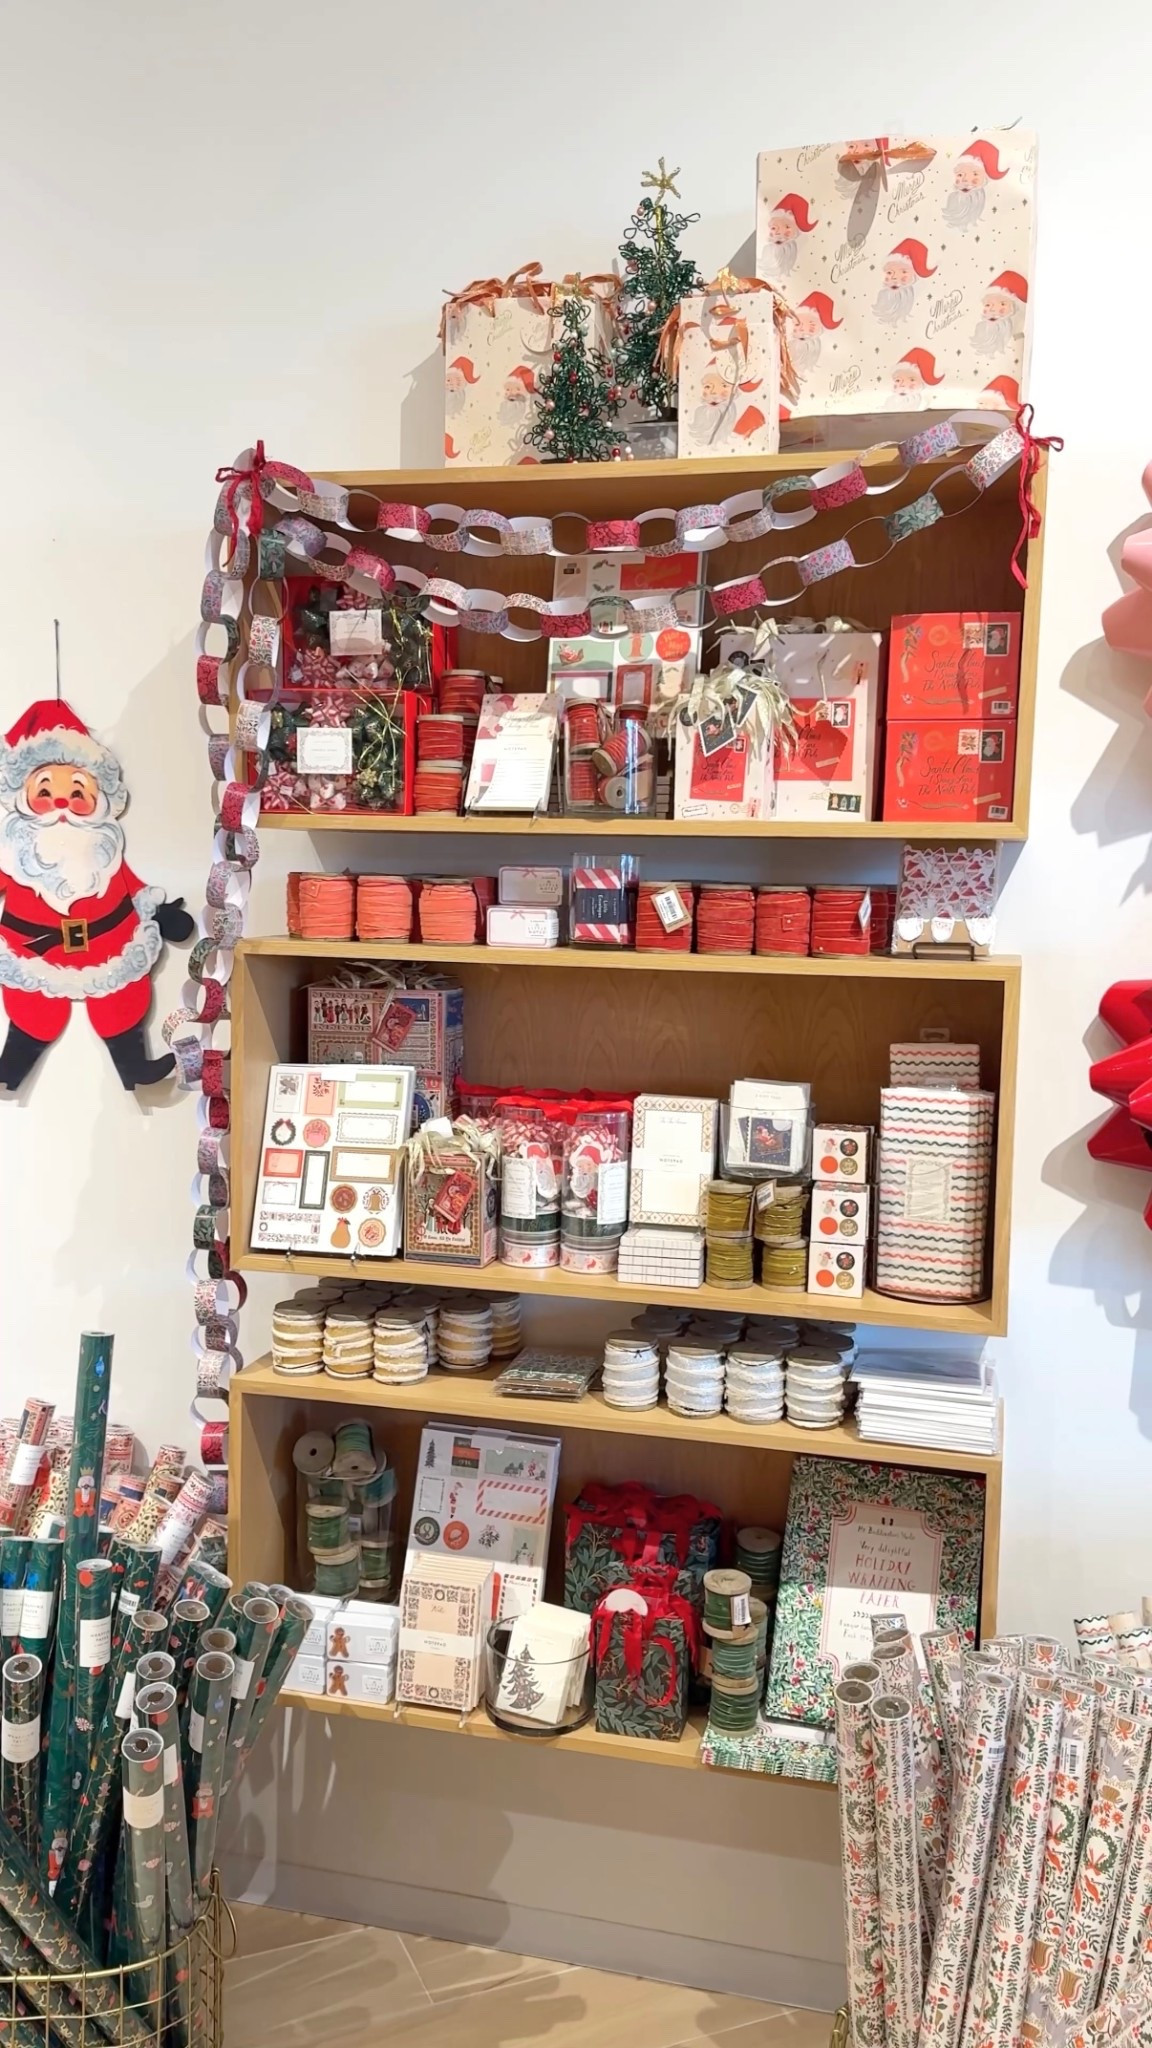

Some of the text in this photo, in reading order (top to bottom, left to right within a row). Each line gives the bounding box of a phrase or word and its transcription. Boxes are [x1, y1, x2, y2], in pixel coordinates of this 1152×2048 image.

[892, 171, 925, 201] Merry
[887, 192, 927, 223] Christmas
[830, 252, 869, 284] Christmas
[930, 289, 963, 319] Merry
[925, 310, 965, 340] Christmas
[829, 365, 862, 393] Merry
[925, 649, 957, 672] Santa
[920, 755, 951, 778] Santa
[918, 784, 931, 796] The
[855, 1553, 912, 1576] HOLIDAY
[848, 1571, 916, 1592] WRAPPING
